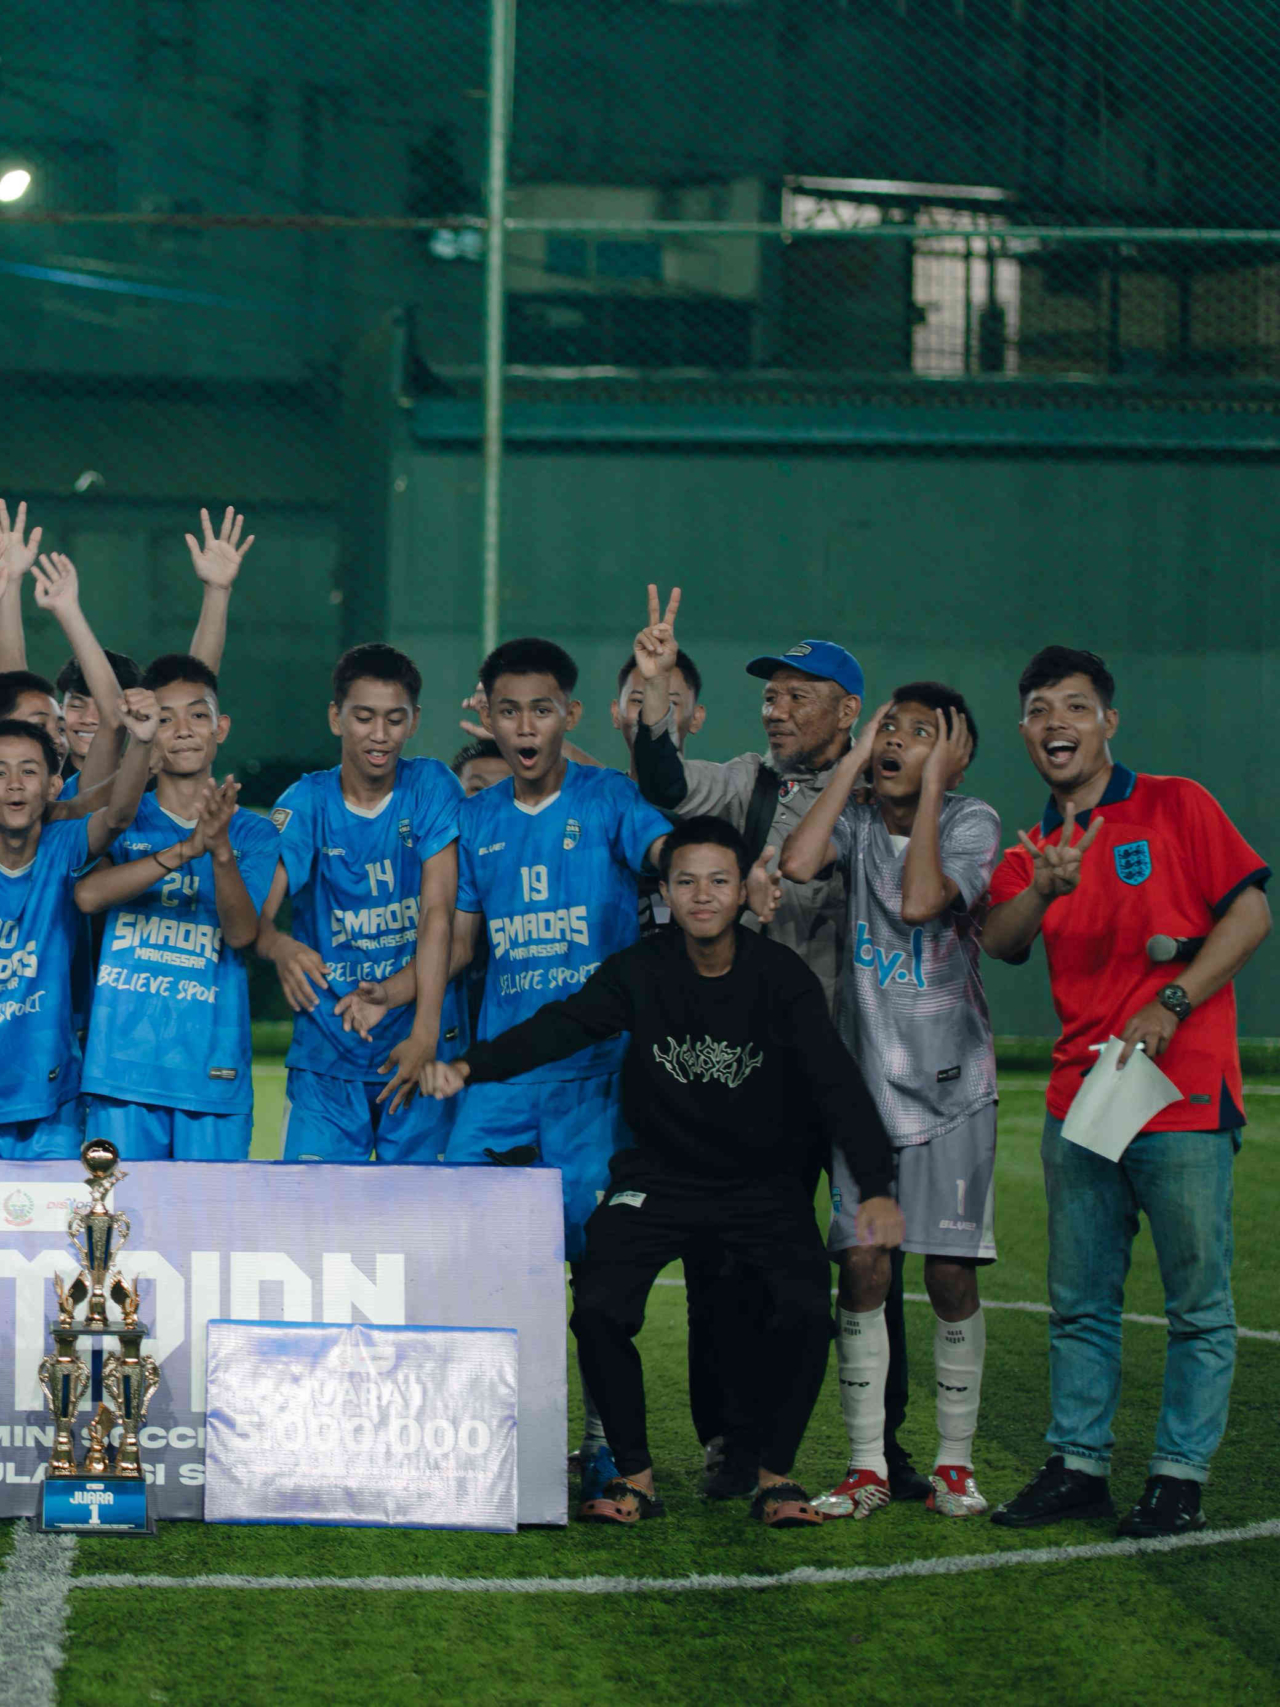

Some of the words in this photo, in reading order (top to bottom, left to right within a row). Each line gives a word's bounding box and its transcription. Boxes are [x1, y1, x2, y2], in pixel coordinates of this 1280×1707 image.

[161, 872, 200, 911] 24
[365, 859, 395, 896] 14
[521, 864, 549, 902] 19
[331, 895, 421, 948] SMADA
[489, 905, 589, 960] SMADAS
[134, 947, 207, 970] MAKASSAR
[97, 965, 174, 996] BELIEVE
[956, 1178, 966, 1216] 1
[69, 1491, 114, 1505] JUARA
[89, 1504, 101, 1524] 1
